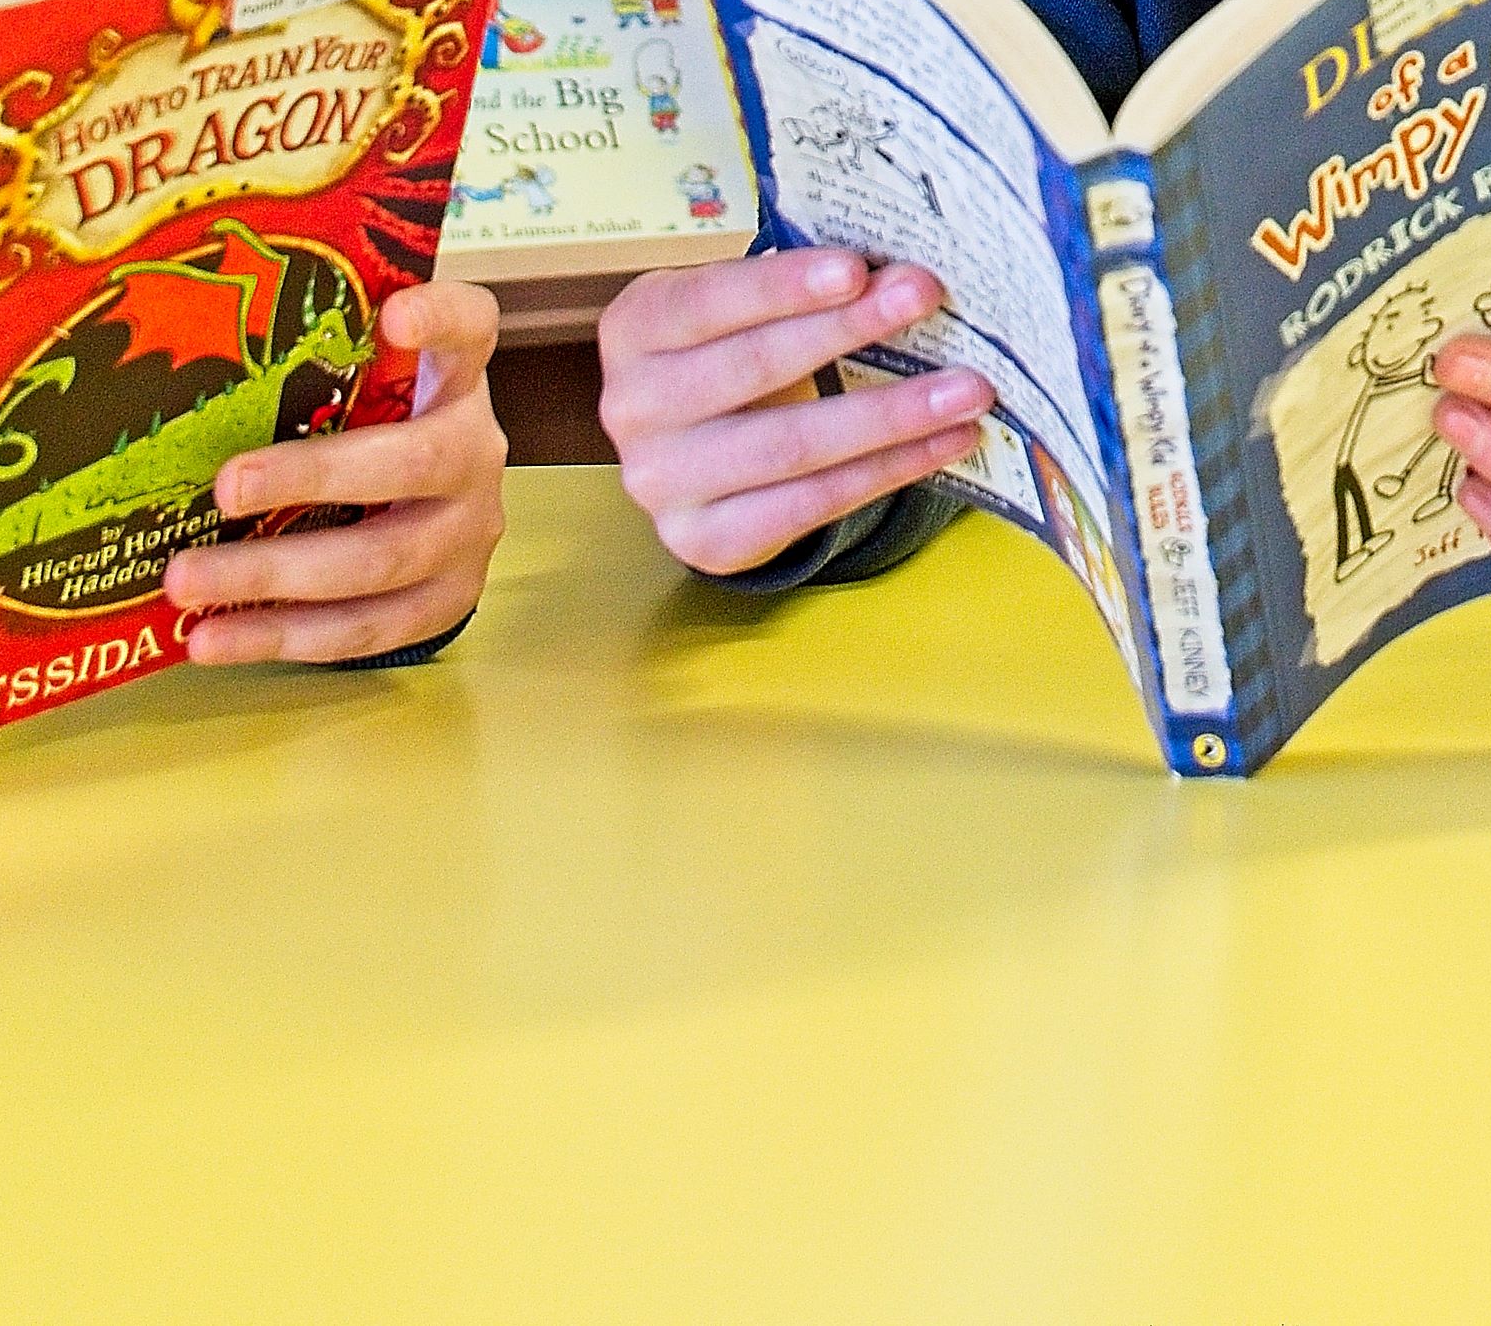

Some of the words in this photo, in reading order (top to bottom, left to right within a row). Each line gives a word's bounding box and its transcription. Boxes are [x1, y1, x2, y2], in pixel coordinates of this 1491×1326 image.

[191, 47, 308, 96] TRAIN
[470, 89, 501, 110] nd
[554, 75, 624, 117] Big
[1367, 57, 1421, 123] of
[1438, 43, 1478, 86] a
[65, 85, 375, 229] DRAGON
[485, 117, 619, 154] School
[1250, 83, 1489, 284] Wimpy
[1280, 192, 1466, 349] RODRICK
[1116, 273, 1160, 335] Diary
[17, 543, 121, 590] Hiccup
[120, 508, 222, 558] Horren
[97, 523, 127, 545] by
[1412, 535, 1463, 567] Jeff
[56, 552, 173, 602] Haddoc
[1167, 569, 1201, 618] JEFF
[1173, 624, 1212, 701] KINNEY
